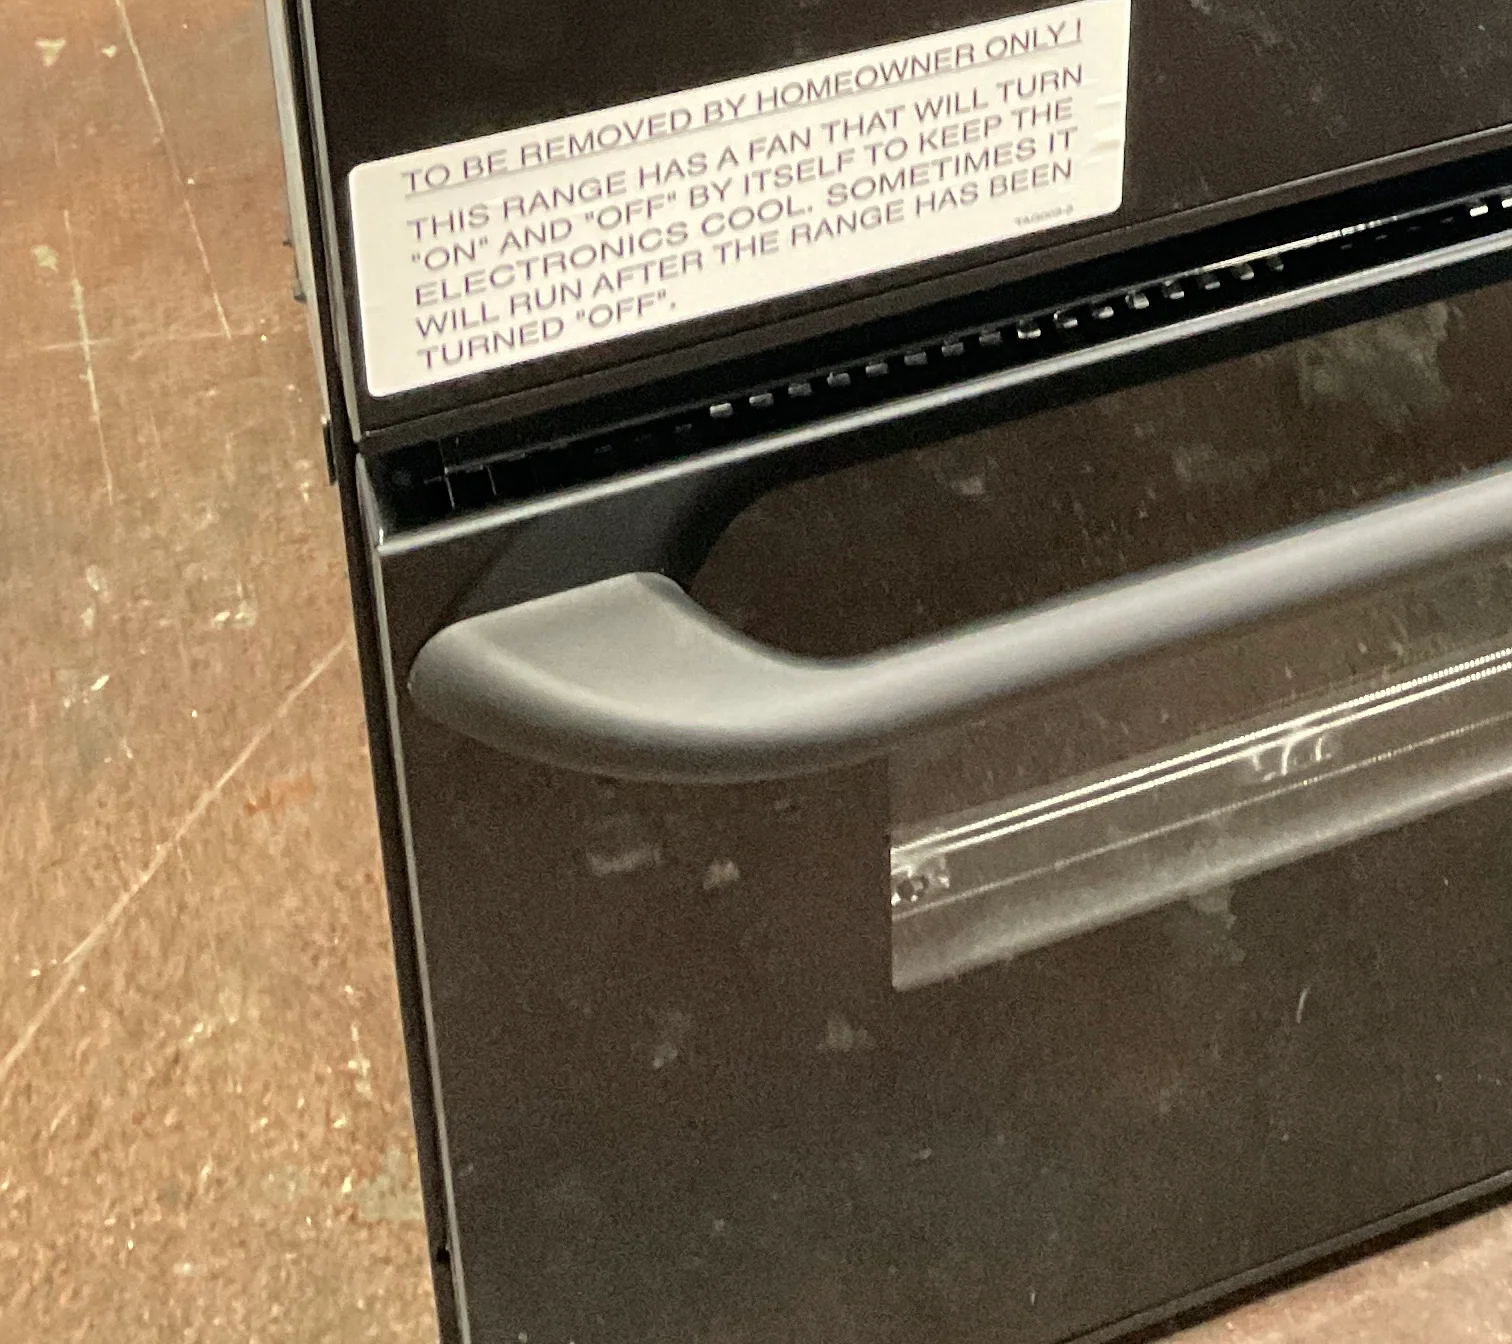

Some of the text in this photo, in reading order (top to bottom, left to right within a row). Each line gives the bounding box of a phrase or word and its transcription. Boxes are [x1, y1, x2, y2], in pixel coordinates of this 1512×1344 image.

[401, 163, 450, 194] TO
[463, 150, 508, 180] BE
[520, 108, 692, 167] REMOVED
[704, 94, 746, 125] BY
[757, 43, 975, 111] HOMEOWNER
[986, 21, 1067, 59] ONLY
[407, 64, 1083, 242] THIS RANGE HAS A FAN THAT WILL TURN
[411, 96, 1074, 272] "ON" AND "OFF" BY ITSELF TO KEEP THE
[416, 125, 1078, 308] ELECTRONICS COOL. SOMETIMES IT
[416, 301, 500, 340] WILL
[510, 278, 583, 317] RUN
[592, 251, 703, 297] AFTER
[712, 229, 780, 265] THE
[791, 199, 904, 249] RANGE
[916, 181, 979, 217] HAS
[990, 159, 1073, 199] BEEN
[417, 289, 677, 369] TURNED "OFF".
